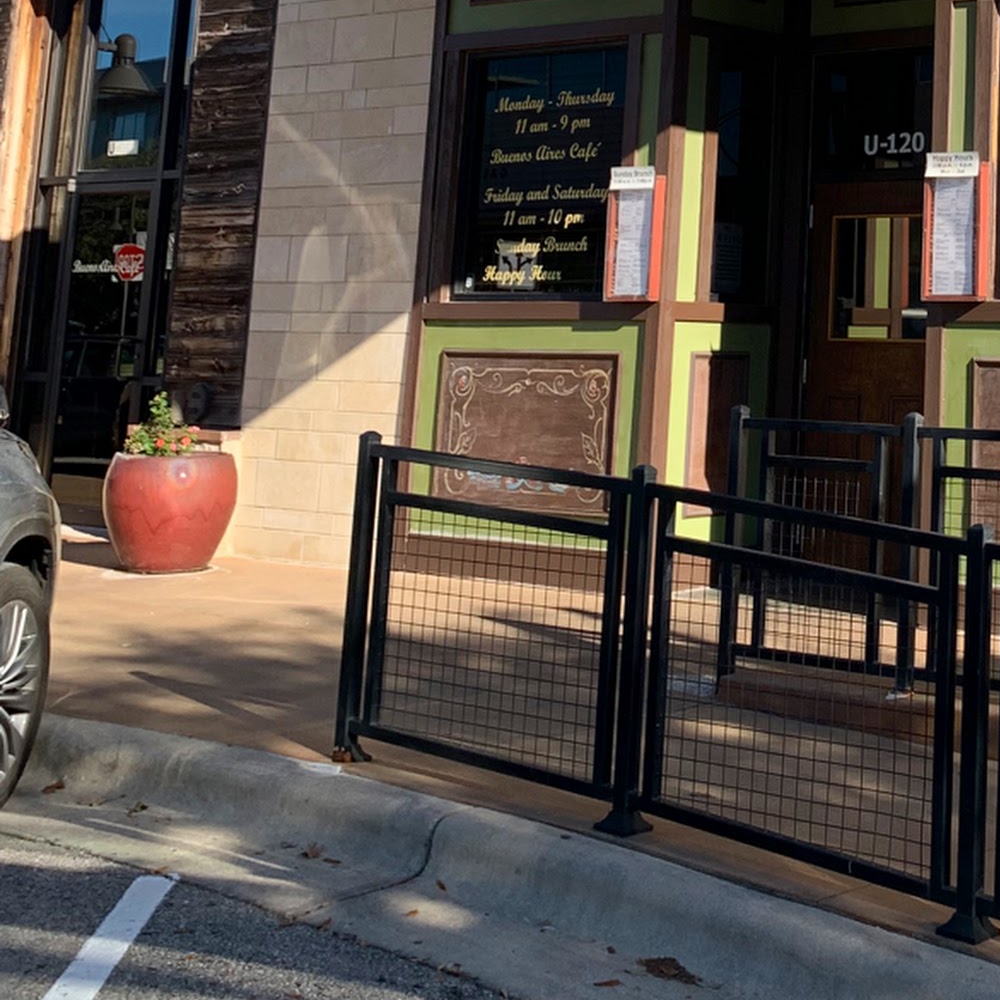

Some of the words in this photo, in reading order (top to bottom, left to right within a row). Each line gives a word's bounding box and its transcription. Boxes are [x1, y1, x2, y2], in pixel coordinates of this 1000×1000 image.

[494, 95, 545, 113] Monday
[556, 88, 615, 107] Thursday
[515, 118, 528, 134] 11
[529, 121, 549, 133] am
[559, 115, 569, 130] 9
[571, 118, 591, 134] pm
[490, 148, 533, 164] Buenos
[536, 144, 566, 161] Aires
[569, 142, 602, 163] Café
[864, 131, 925, 156] U-120
[483, 187, 524, 206] Friday
[526, 184, 551, 200] and
[552, 183, 609, 203] Saturday
[503, 210, 516, 227] 11
[518, 214, 537, 226] am
[547, 208, 563, 225] 10
[564, 213, 585, 229] pm
[494, 238, 541, 258] Sunday
[542, 236, 589, 253] Brunch
[482, 265, 526, 287] Happy
[528, 264, 562, 282] Hour
